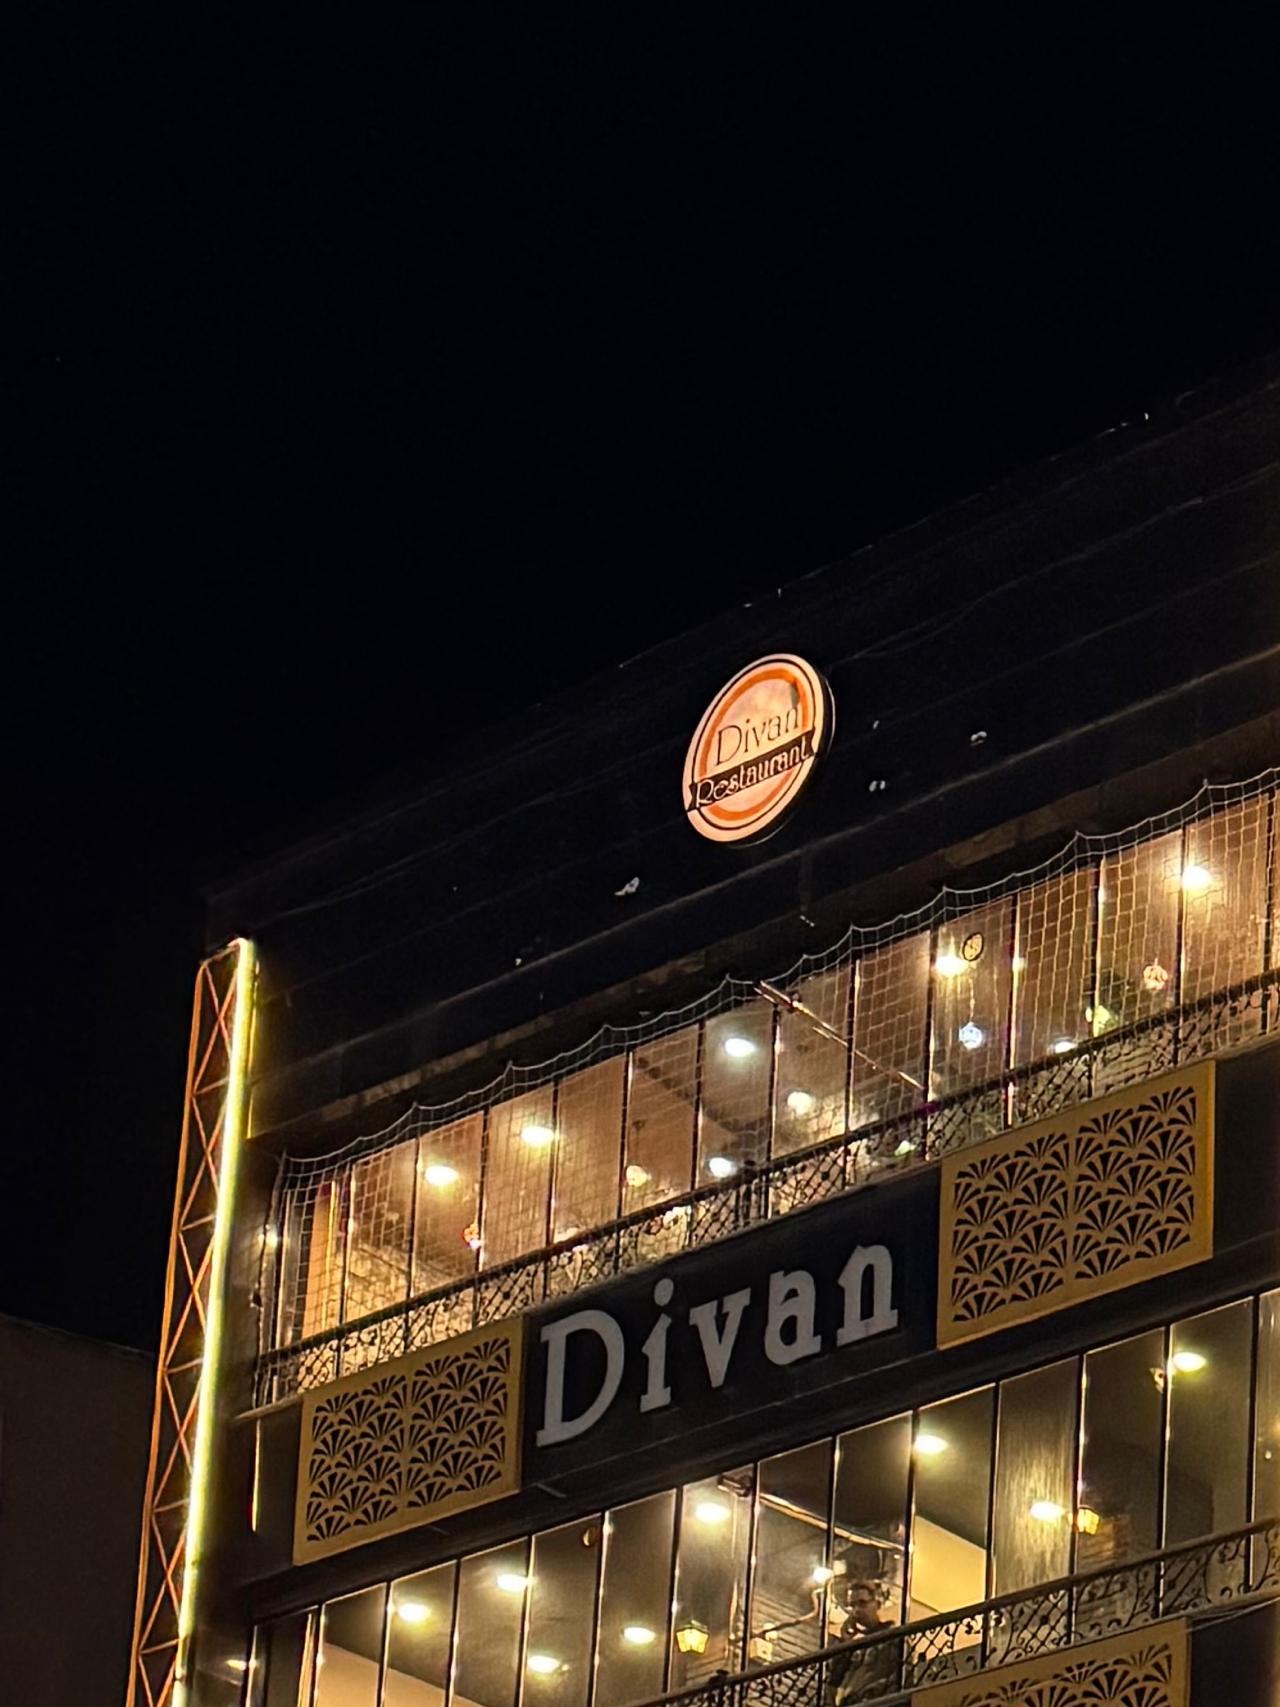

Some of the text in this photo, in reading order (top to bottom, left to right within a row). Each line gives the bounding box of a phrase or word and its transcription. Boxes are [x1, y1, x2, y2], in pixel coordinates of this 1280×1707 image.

[717, 705, 799, 765] Divan
[696, 736, 812, 808] Restaurant
[536, 1240, 899, 1447] Divan
